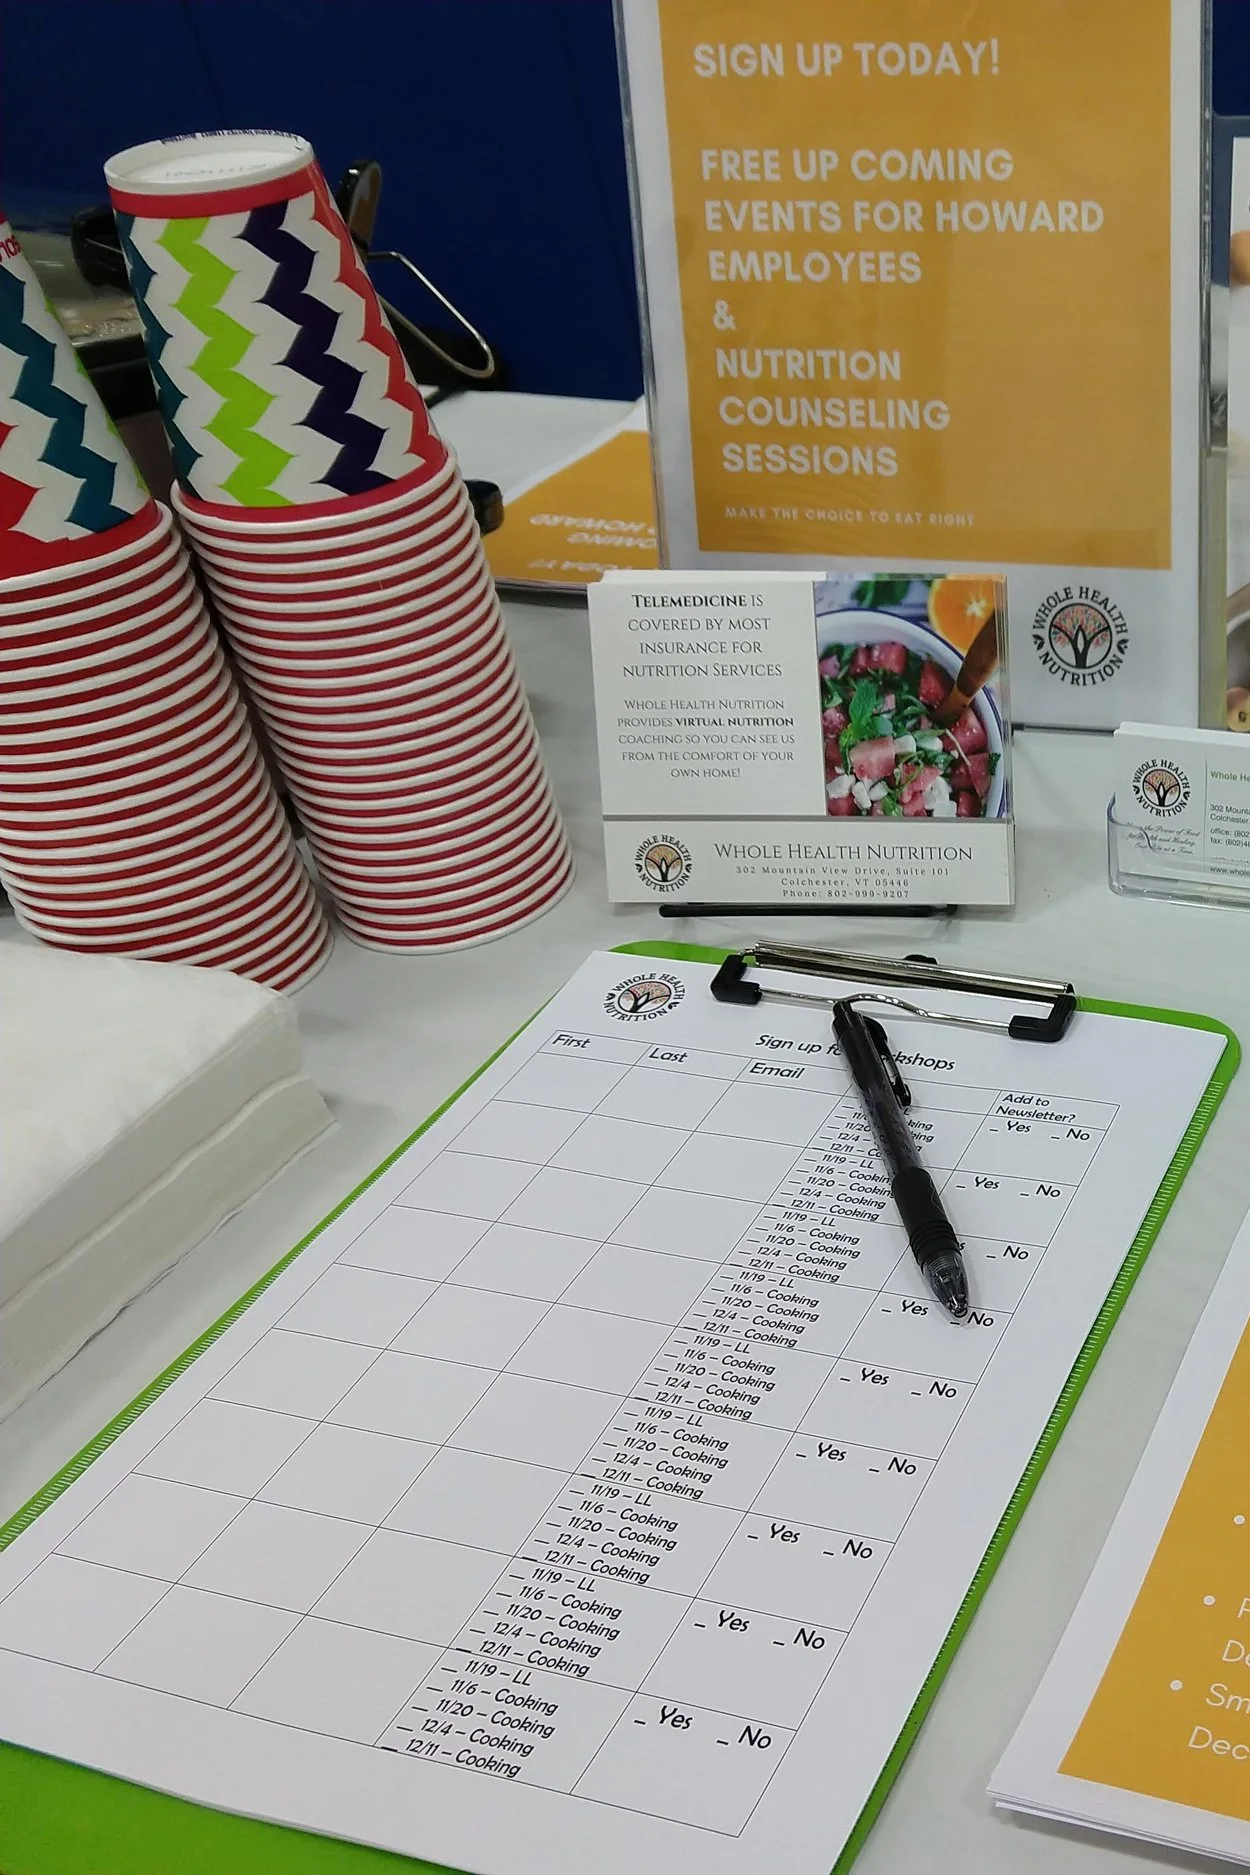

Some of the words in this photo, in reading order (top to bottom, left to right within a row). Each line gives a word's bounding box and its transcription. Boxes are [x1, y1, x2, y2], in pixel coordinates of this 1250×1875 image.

[694, 43, 784, 77] SIGN
[797, 42, 842, 77] UP
[853, 38, 999, 76] TODAY!
[701, 149, 781, 181] FREE
[793, 148, 839, 181] UP
[851, 148, 1013, 181] COMING
[705, 200, 841, 232] EVENTS
[854, 200, 923, 232] FOR
[936, 200, 1104, 232] HOWARD
[709, 250, 922, 283] EMPLOYEES
[713, 300, 735, 330] &
[716, 348, 900, 380] NUTRITION
[719, 396, 950, 430] COUNSELING
[722, 443, 898, 477] SESSIONS
[724, 505, 767, 521] MAKE
[771, 506, 800, 521] THE
[803, 507, 864, 523] CHOICE
[869, 509, 890, 525] TO
[894, 511, 923, 526] EAT
[928, 511, 975, 527] RIGHT
[631, 594, 747, 608] TELEMEDICINE
[751, 594, 764, 607] IS
[627, 618, 701, 632] COVERED
[705, 618, 724, 631] BY
[728, 617, 771, 631] MOST
[639, 640, 728, 655] INSURANCE
[731, 640, 763, 654] FOR
[623, 664, 709, 678] NUTRITION
[712, 662, 782, 677] SERVICES
[617, 718, 673, 727] PROVIDES
[674, 717, 723, 727] VIRTUAL
[727, 717, 794, 727] NUTRITION
[670, 768, 700, 778] OWN
[702, 767, 741, 778] HOME!
[1210, 770, 1238, 781] Whole
[1209, 803, 1224, 813] 302
[1209, 813, 1250, 825] Colchester,
[1209, 827, 1231, 836] office:
[1209, 836, 1223, 845] fax:
[713, 843, 783, 859] WHOLE
[788, 844, 860, 859] HEALTH
[868, 845, 971, 860] NUTRITION
[782, 889, 822, 898] Phone:
[827, 889, 909, 899] 802-999-9207
[754, 1034, 793, 1054] Sign
[797, 1042, 822, 1058] up
[552, 1033, 591, 1050] First
[649, 1047, 688, 1064] Last
[749, 1062, 805, 1081] Email
[1002, 1092, 1030, 1106] Add
[1032, 1095, 1051, 1107] to
[996, 1105, 1077, 1124] Newsletter?
[1005, 1120, 1032, 1134] Yes
[1067, 1128, 1091, 1142] No
[683, 1347, 706, 1362] 11/6
[722, 1354, 777, 1376] Cooking
